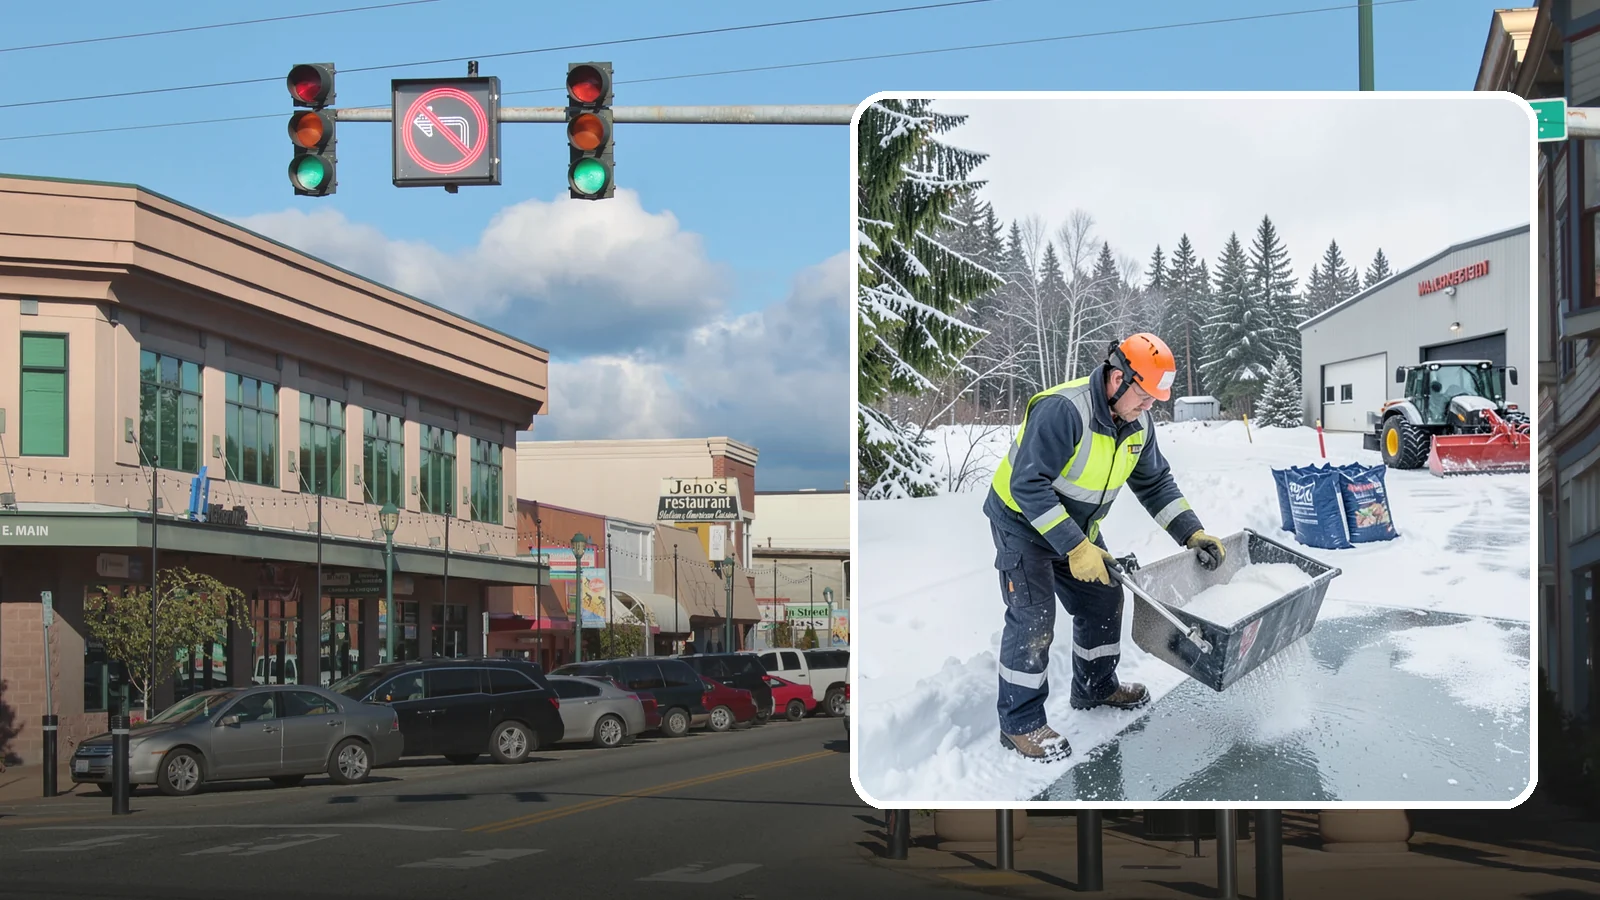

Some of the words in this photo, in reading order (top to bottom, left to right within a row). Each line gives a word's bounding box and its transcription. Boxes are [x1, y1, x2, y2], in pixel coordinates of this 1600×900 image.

[669, 480, 728, 495] Jeno's
[665, 496, 731, 509] restaurant
[658, 509, 682, 520] Italian
[686, 509, 715, 520] American
[715, 509, 738, 520] Cuisine
[2, 525, 13, 536] E.
[15, 525, 49, 536] MAIN
[797, 607, 829, 617] Street
